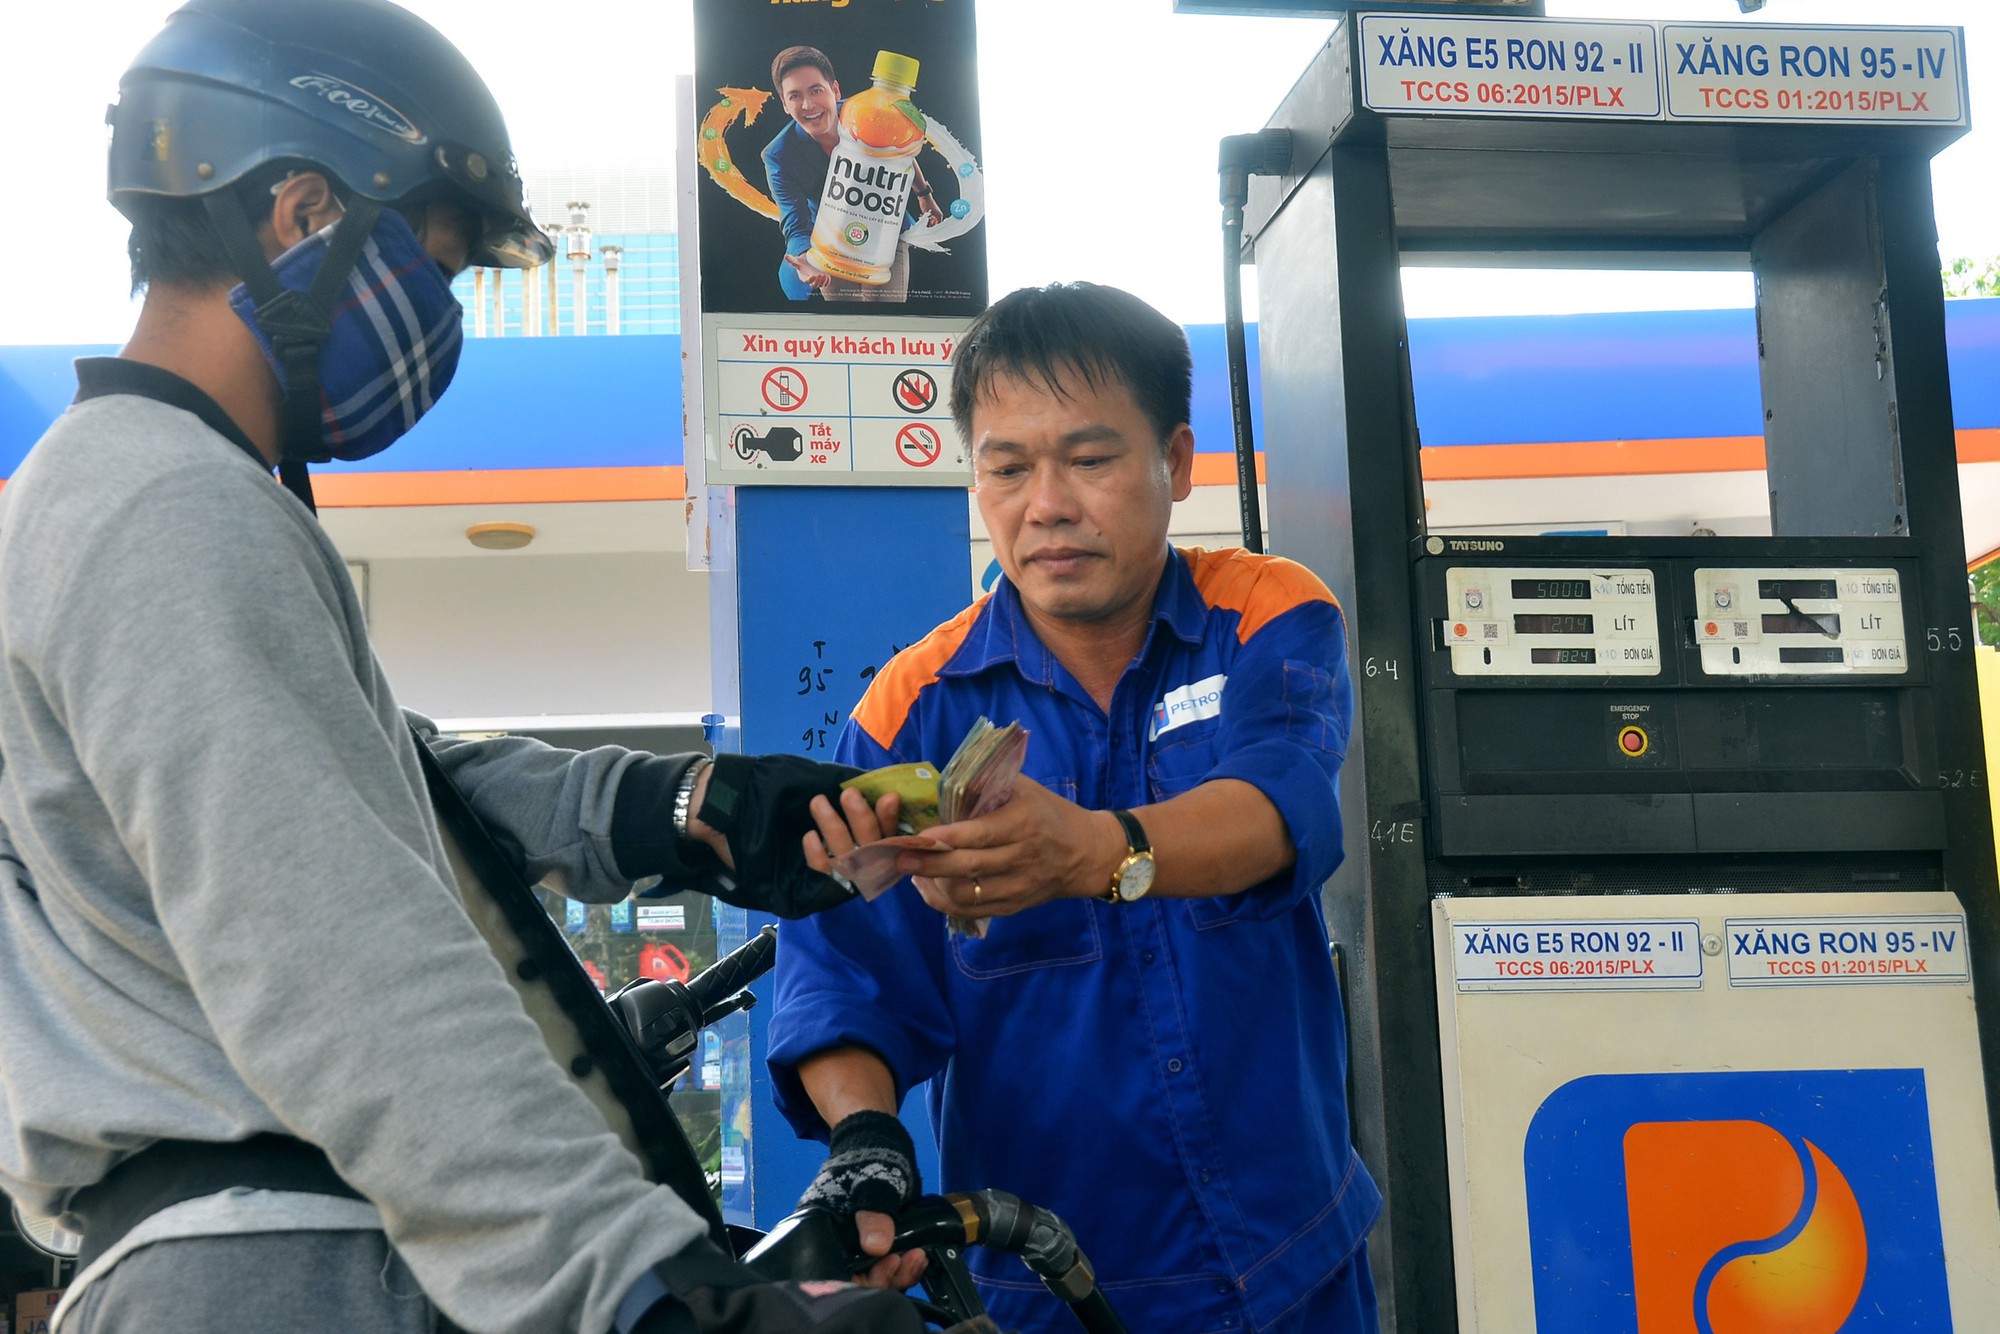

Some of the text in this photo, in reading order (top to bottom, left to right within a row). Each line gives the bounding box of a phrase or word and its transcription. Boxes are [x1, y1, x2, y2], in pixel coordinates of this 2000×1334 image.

[1378, 27, 1644, 74] XĂNG E5 RON 92 - II
[1676, 36, 1769, 77] XĂNG
[1780, 46, 1850, 79] RON
[1860, 47, 1896, 79] 95
[1401, 80, 1624, 107] TCCS 06:2015/PLX
[1699, 87, 1929, 112] TCCS 01:2015/PLX
[834, 155, 912, 193] nutri
[827, 175, 904, 218] boost
[954, 203, 967, 212] Zn
[743, 334, 953, 360] Xin quý khách lưu ý
[809, 422, 832, 437] Tắt
[810, 438, 841, 454] máy
[810, 454, 828, 464] xe
[1449, 540, 1505, 551] TATSUNO
[1537, 582, 1585, 598] 5000
[1614, 614, 1636, 631] LÍT
[1860, 613, 1882, 630] LÍT
[1927, 627, 1962, 652] 5.5
[813, 640, 826, 659] T
[1555, 650, 1589, 663] 1824
[1365, 656, 1399, 681] 6.4
[1170, 690, 1222, 715] PETRO
[824, 710, 838, 725] N
[1622, 712, 1640, 720] STOP
[1464, 928, 1529, 955] XĂNG
[1537, 933, 1564, 954] E5
[1571, 932, 1620, 953] RON
[1626, 932, 1652, 953] 92
[1734, 928, 1811, 956] XĂNG
[1819, 933, 1878, 954] RON
[1886, 932, 1915, 953] 95
[1496, 960, 1655, 976] TCCS 06:2015/PLX
[1767, 959, 1928, 975] TCCS 01:2015/PLX
